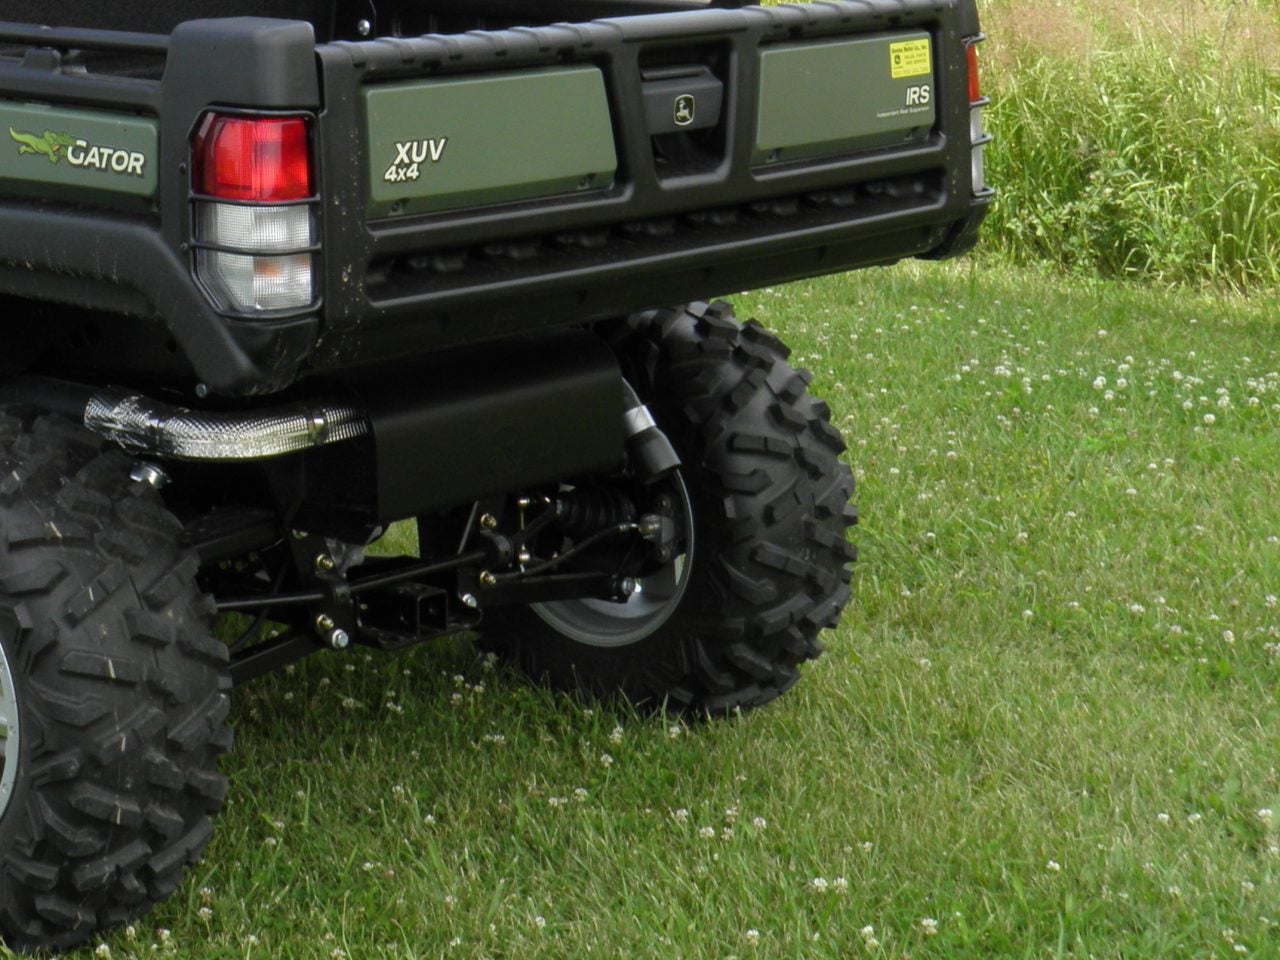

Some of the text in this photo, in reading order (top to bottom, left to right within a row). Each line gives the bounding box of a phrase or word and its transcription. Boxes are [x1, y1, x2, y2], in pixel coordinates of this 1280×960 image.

[906, 85, 930, 106] IRS
[67, 139, 145, 175] GATOR
[393, 138, 447, 165] XUV
[384, 163, 420, 182] 4x4
